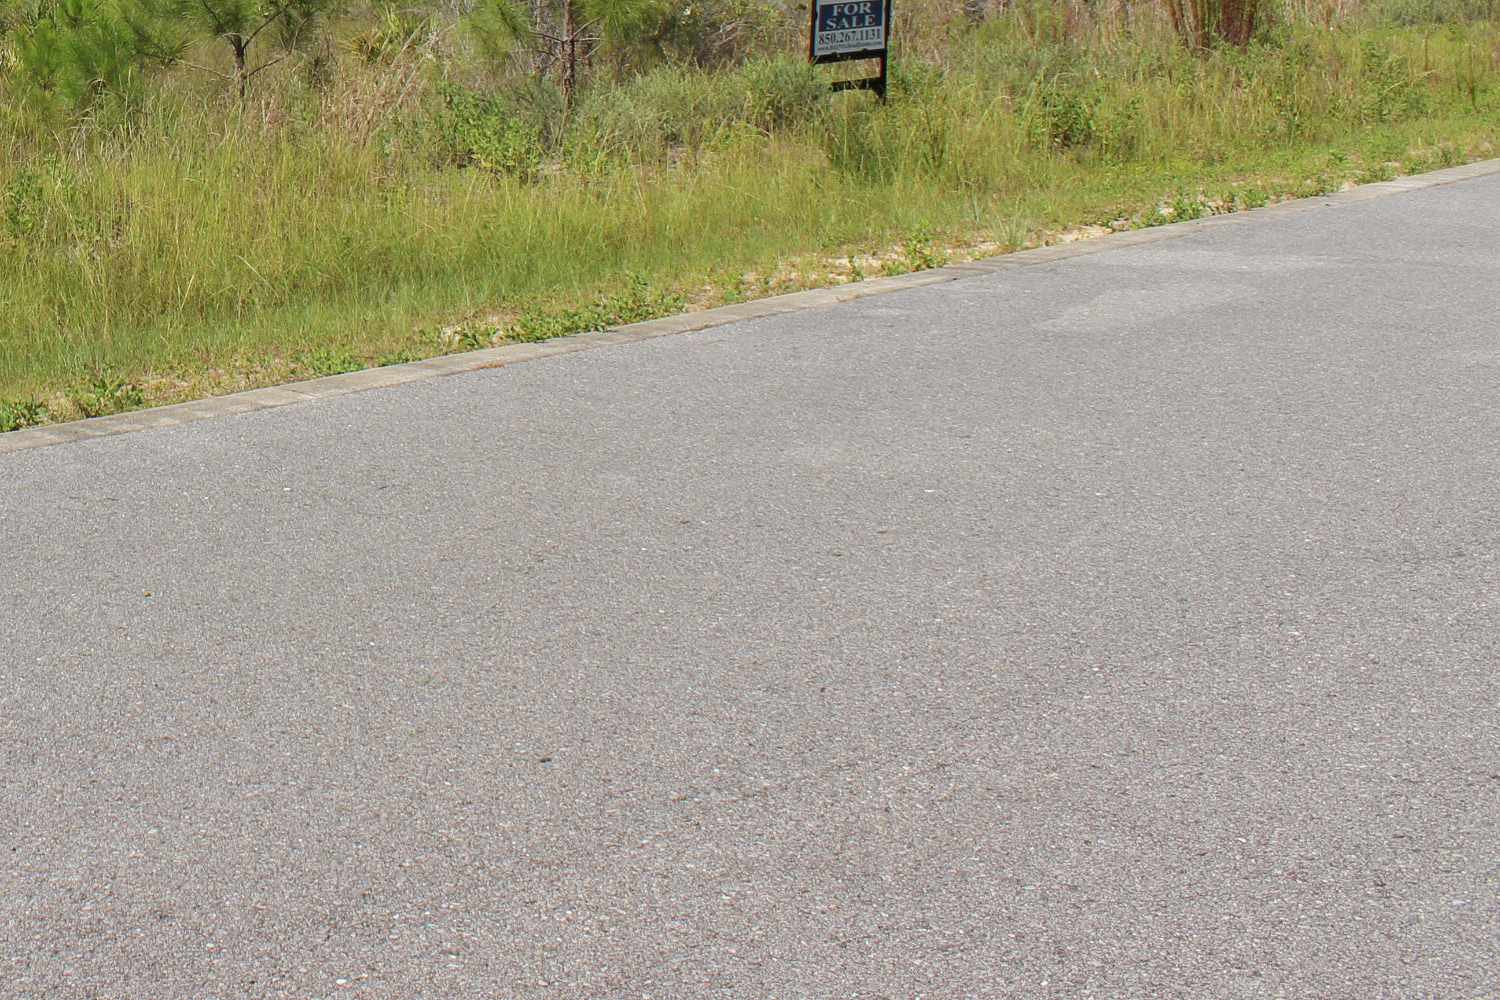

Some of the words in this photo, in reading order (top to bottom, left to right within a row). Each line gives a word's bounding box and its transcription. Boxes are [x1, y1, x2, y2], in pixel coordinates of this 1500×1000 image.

[832, 2, 872, 17] FOR
[826, 15, 875, 30] SALE
[818, 29, 880, 45] 850.267.1131
